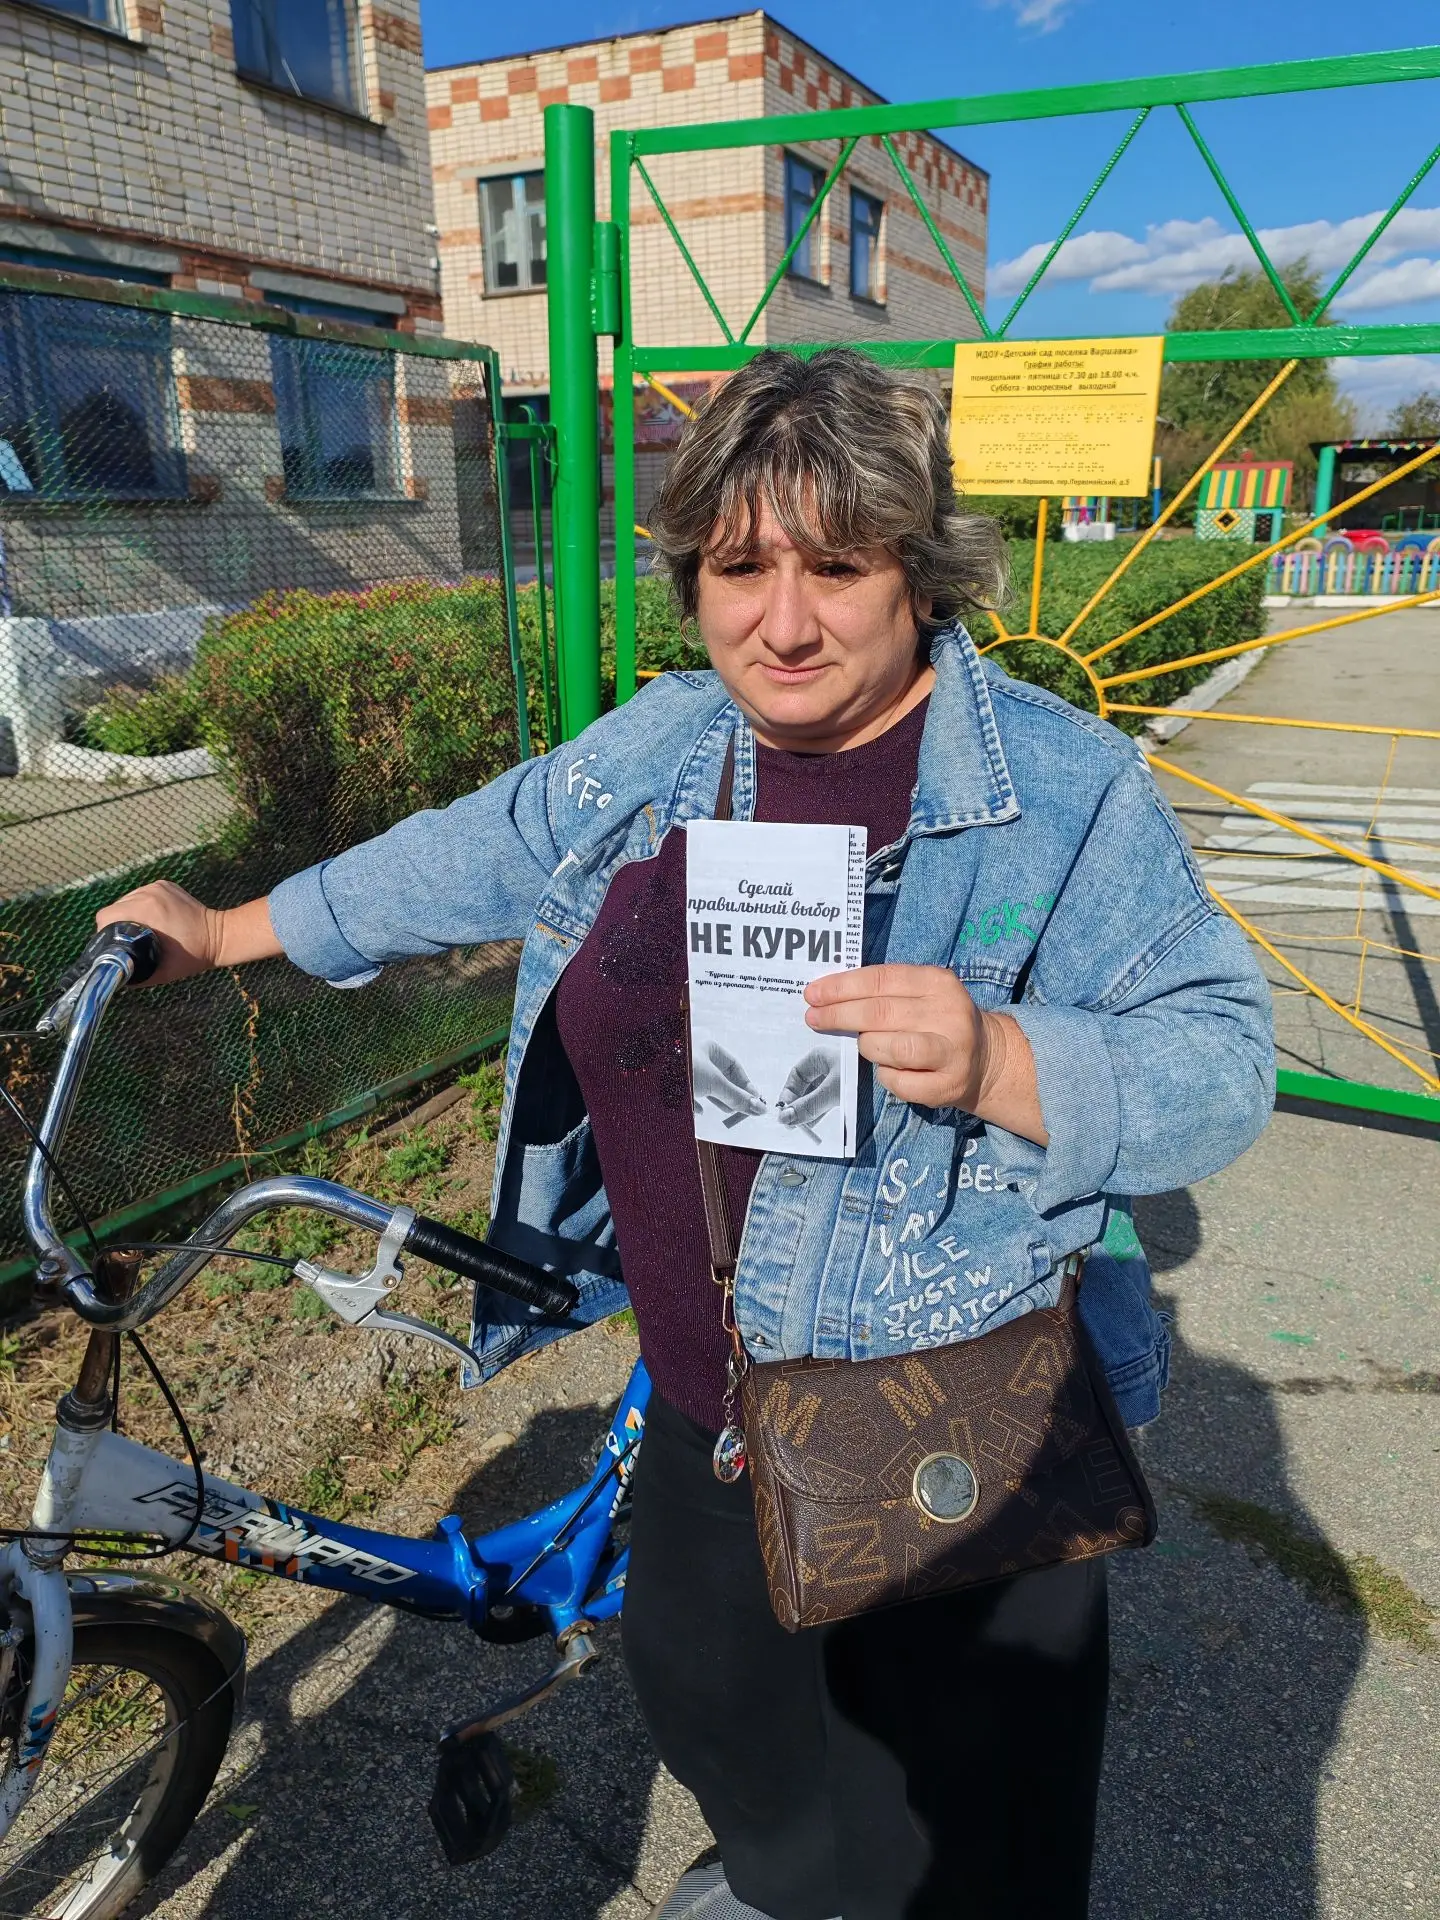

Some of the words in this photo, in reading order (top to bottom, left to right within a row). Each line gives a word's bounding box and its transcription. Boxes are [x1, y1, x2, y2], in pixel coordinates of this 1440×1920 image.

[738, 879, 794, 898] Сделай
[687, 897, 788, 915] правильный
[790, 900, 841, 922] выбор
[690, 921, 733, 956] НЕ
[742, 925, 842, 964] КУРИ!
[884, 1276, 957, 1327] JUST
